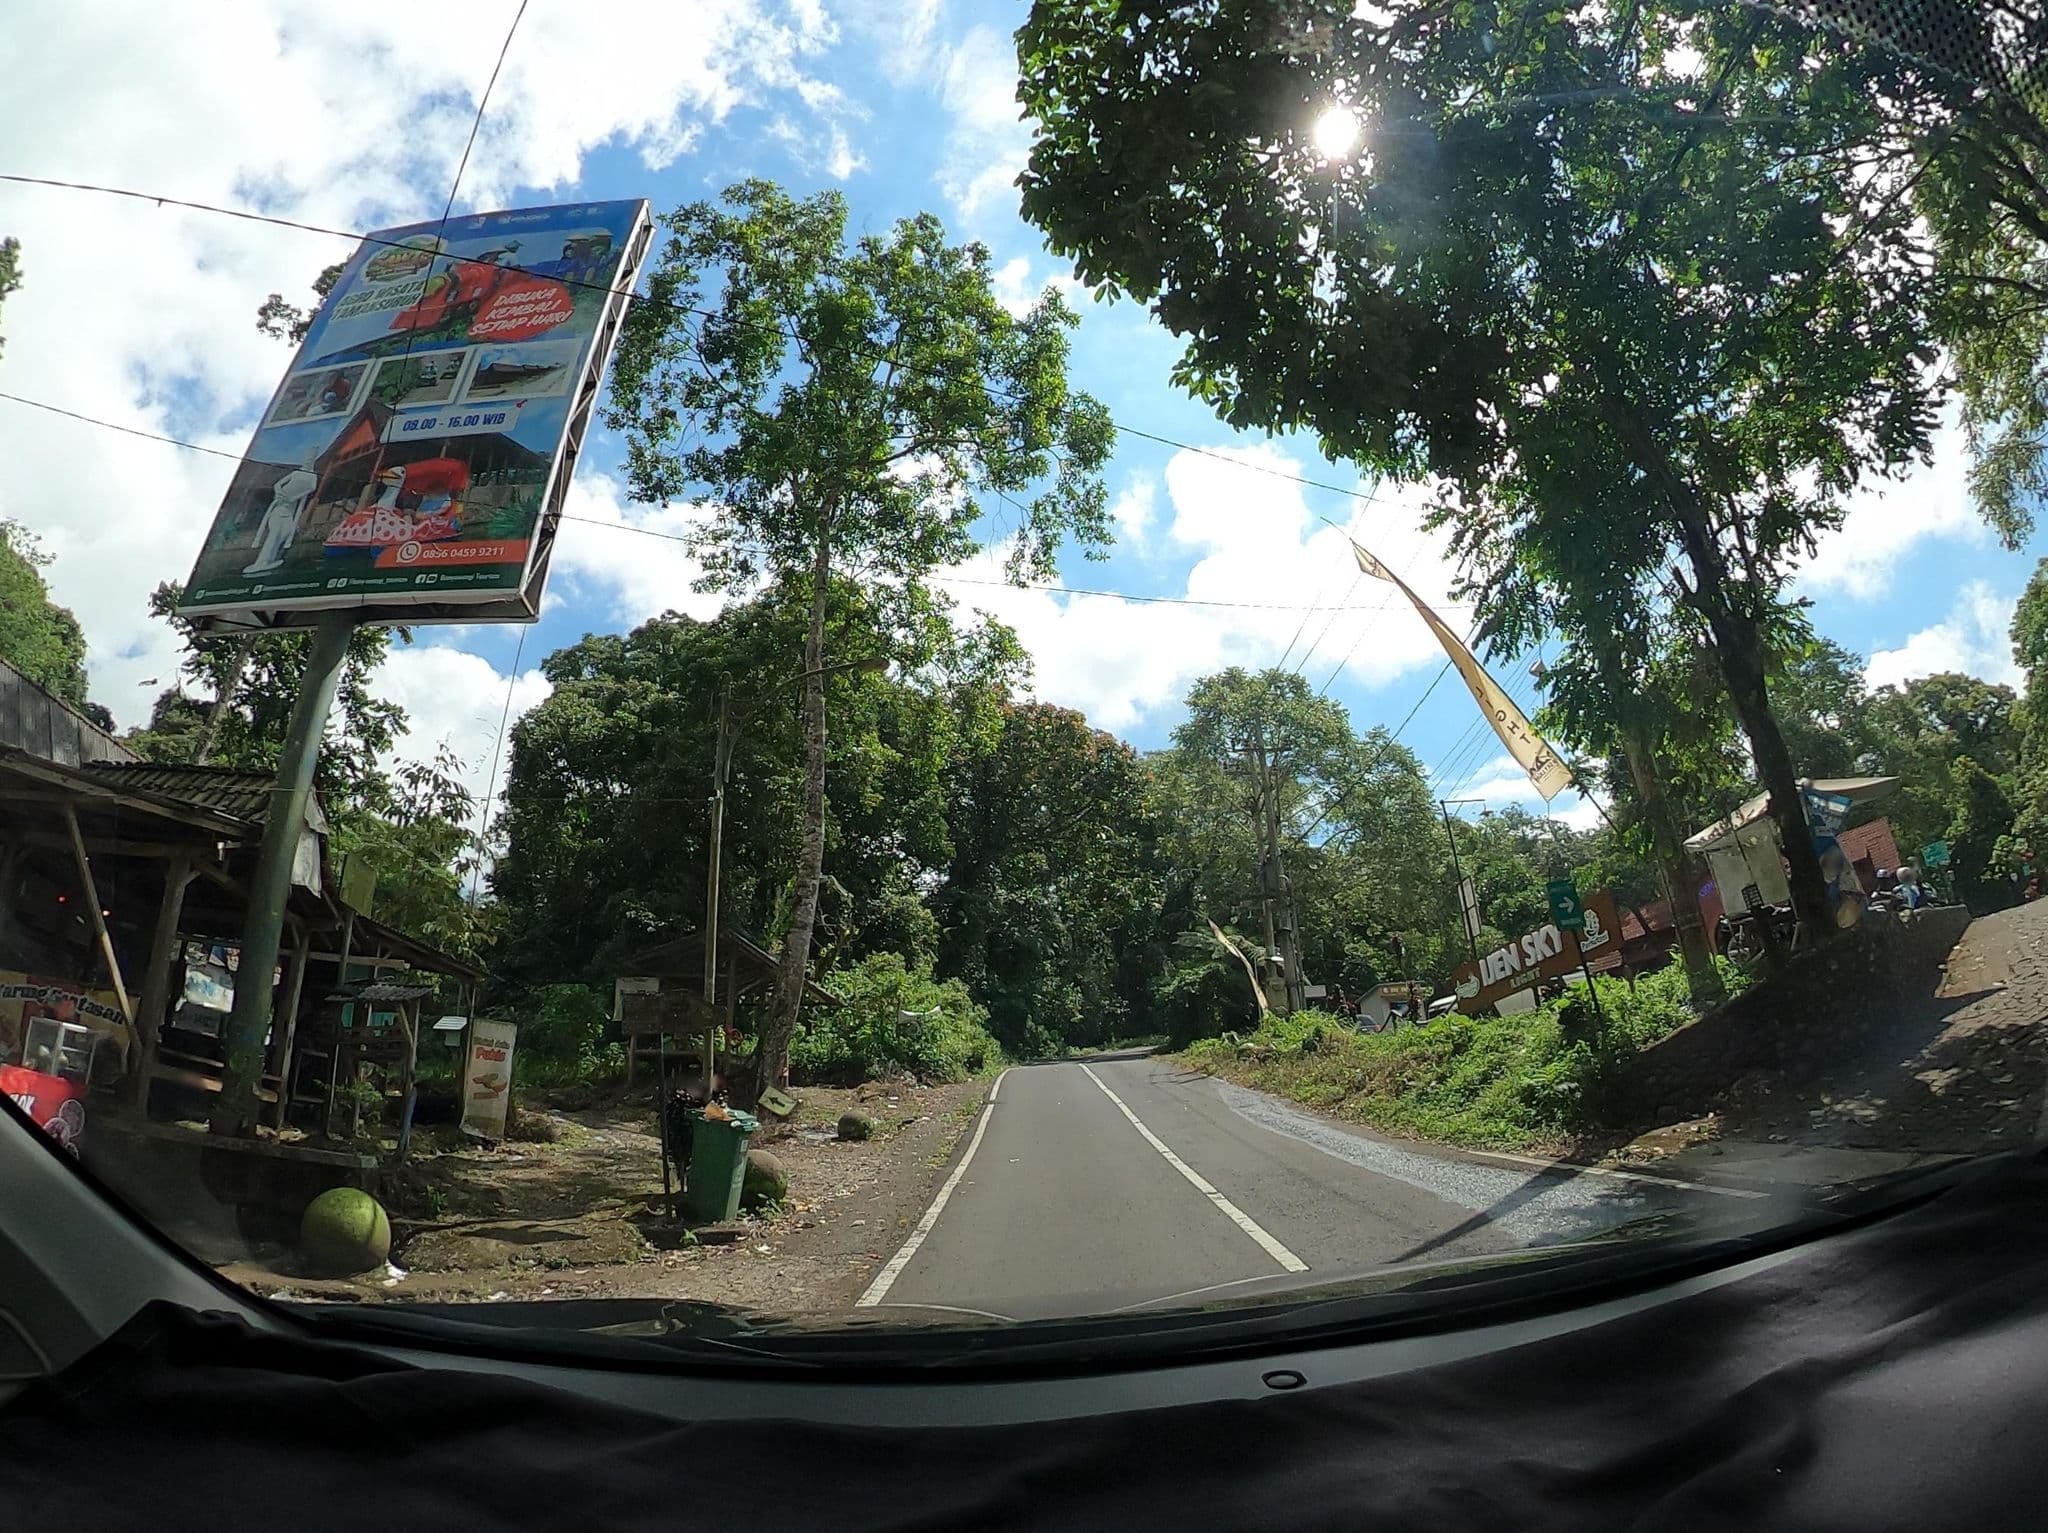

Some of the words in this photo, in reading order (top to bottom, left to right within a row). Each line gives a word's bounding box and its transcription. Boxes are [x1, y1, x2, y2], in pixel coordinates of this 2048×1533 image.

[493, 287, 558, 307] DIBUKA
[485, 299, 562, 321] KEMBALI
[468, 316, 528, 336] SETIAP
[526, 310, 574, 327] HARI
[402, 418, 438, 432] 08.00
[447, 415, 479, 428] 16.00
[483, 413, 506, 426] WIB
[450, 547, 477, 558] 0459
[479, 546, 505, 557] 9211
[1521, 924, 1563, 967] SKY
[0, 984, 47, 1003] arung
